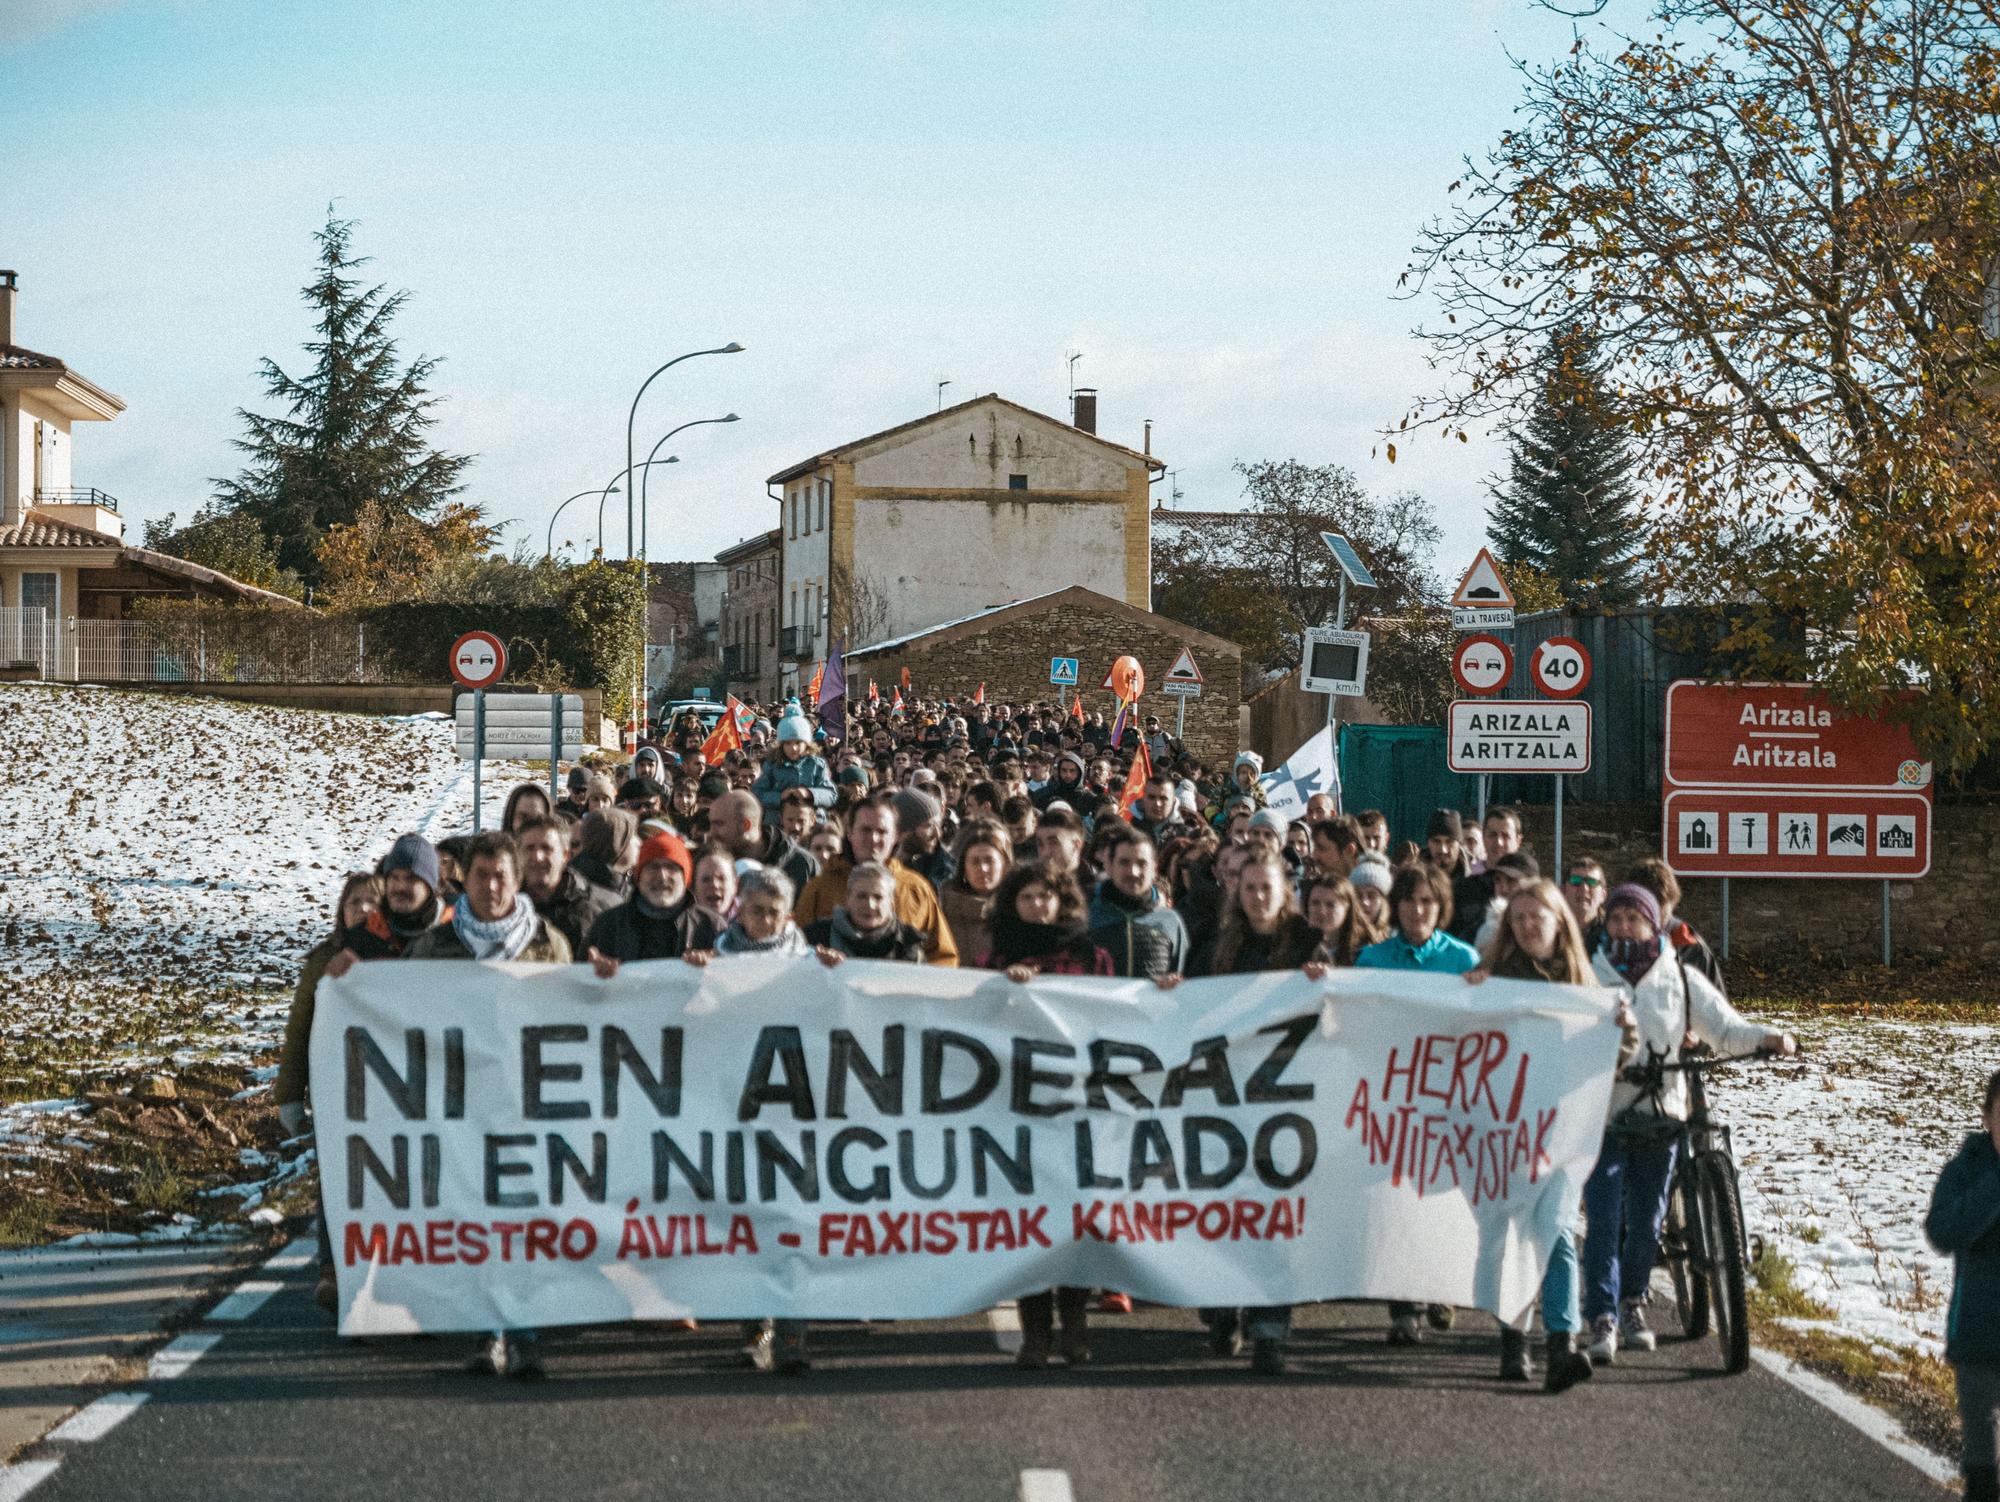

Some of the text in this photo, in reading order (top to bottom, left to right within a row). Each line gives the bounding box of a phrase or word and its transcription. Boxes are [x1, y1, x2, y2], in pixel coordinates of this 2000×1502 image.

[1455, 612, 1512, 625] EN LA TRAVESÍA
[1310, 629, 1365, 640] ZURE ABIADURA
[1323, 637, 1361, 646] VELOCIDAD
[1544, 658, 1579, 679] 40
[1335, 682, 1360, 693] km/h
[1469, 713, 1571, 732] ARIZALA
[1739, 702, 1831, 726] Arizala
[1460, 741, 1578, 760] ARITZALA
[1732, 742, 1836, 767] Aritzala
[343, 1013, 1321, 1122] NI EN ANDERAZ
[1381, 1030, 1529, 1124] HERRI
[1344, 1077, 1557, 1207] ANTIFAXISTAK
[346, 1112, 1318, 1211] NI EN NINGUN LADO
[343, 1217, 597, 1267] MAESTRO
[616, 1196, 760, 1261] ÁVILA
[818, 1204, 1053, 1258] FAXISTAK
[1072, 1196, 1306, 1244] KANPORA!
